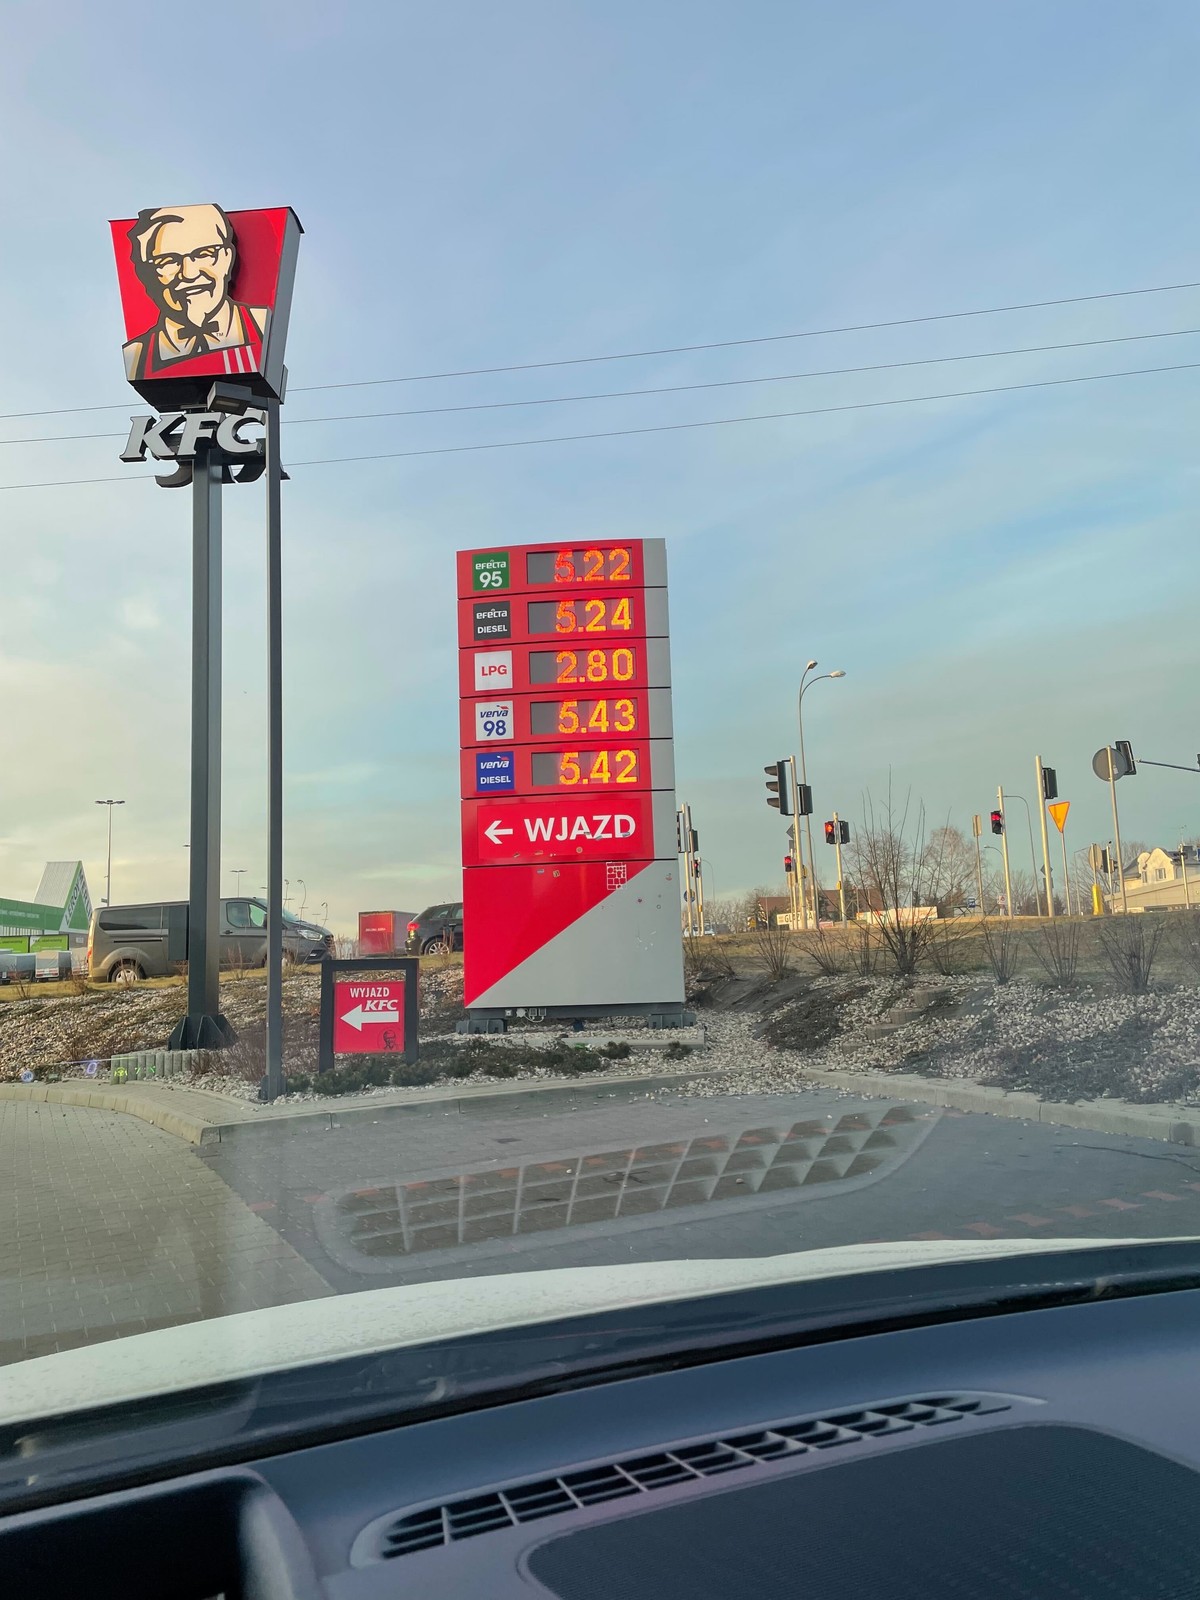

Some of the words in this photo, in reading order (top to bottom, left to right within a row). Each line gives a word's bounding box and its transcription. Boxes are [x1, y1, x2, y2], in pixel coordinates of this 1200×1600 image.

[119, 407, 267, 462] KFC
[554, 548, 630, 583] 5.22
[479, 571, 503, 588] 95
[556, 598, 631, 633] 5.24
[477, 624, 508, 634] DIESEL
[481, 665, 507, 676] LPG
[556, 648, 634, 683] 2.80
[480, 708, 509, 718] verva
[558, 699, 635, 734] 5.43
[483, 720, 507, 736] 98
[480, 760, 510, 769] verva
[560, 750, 637, 785] 5.42
[480, 776, 511, 784] DIESEL
[524, 814, 636, 842] WJAZD
[350, 987, 390, 998] WYJAZD
[364, 1000, 398, 1011] KFC
